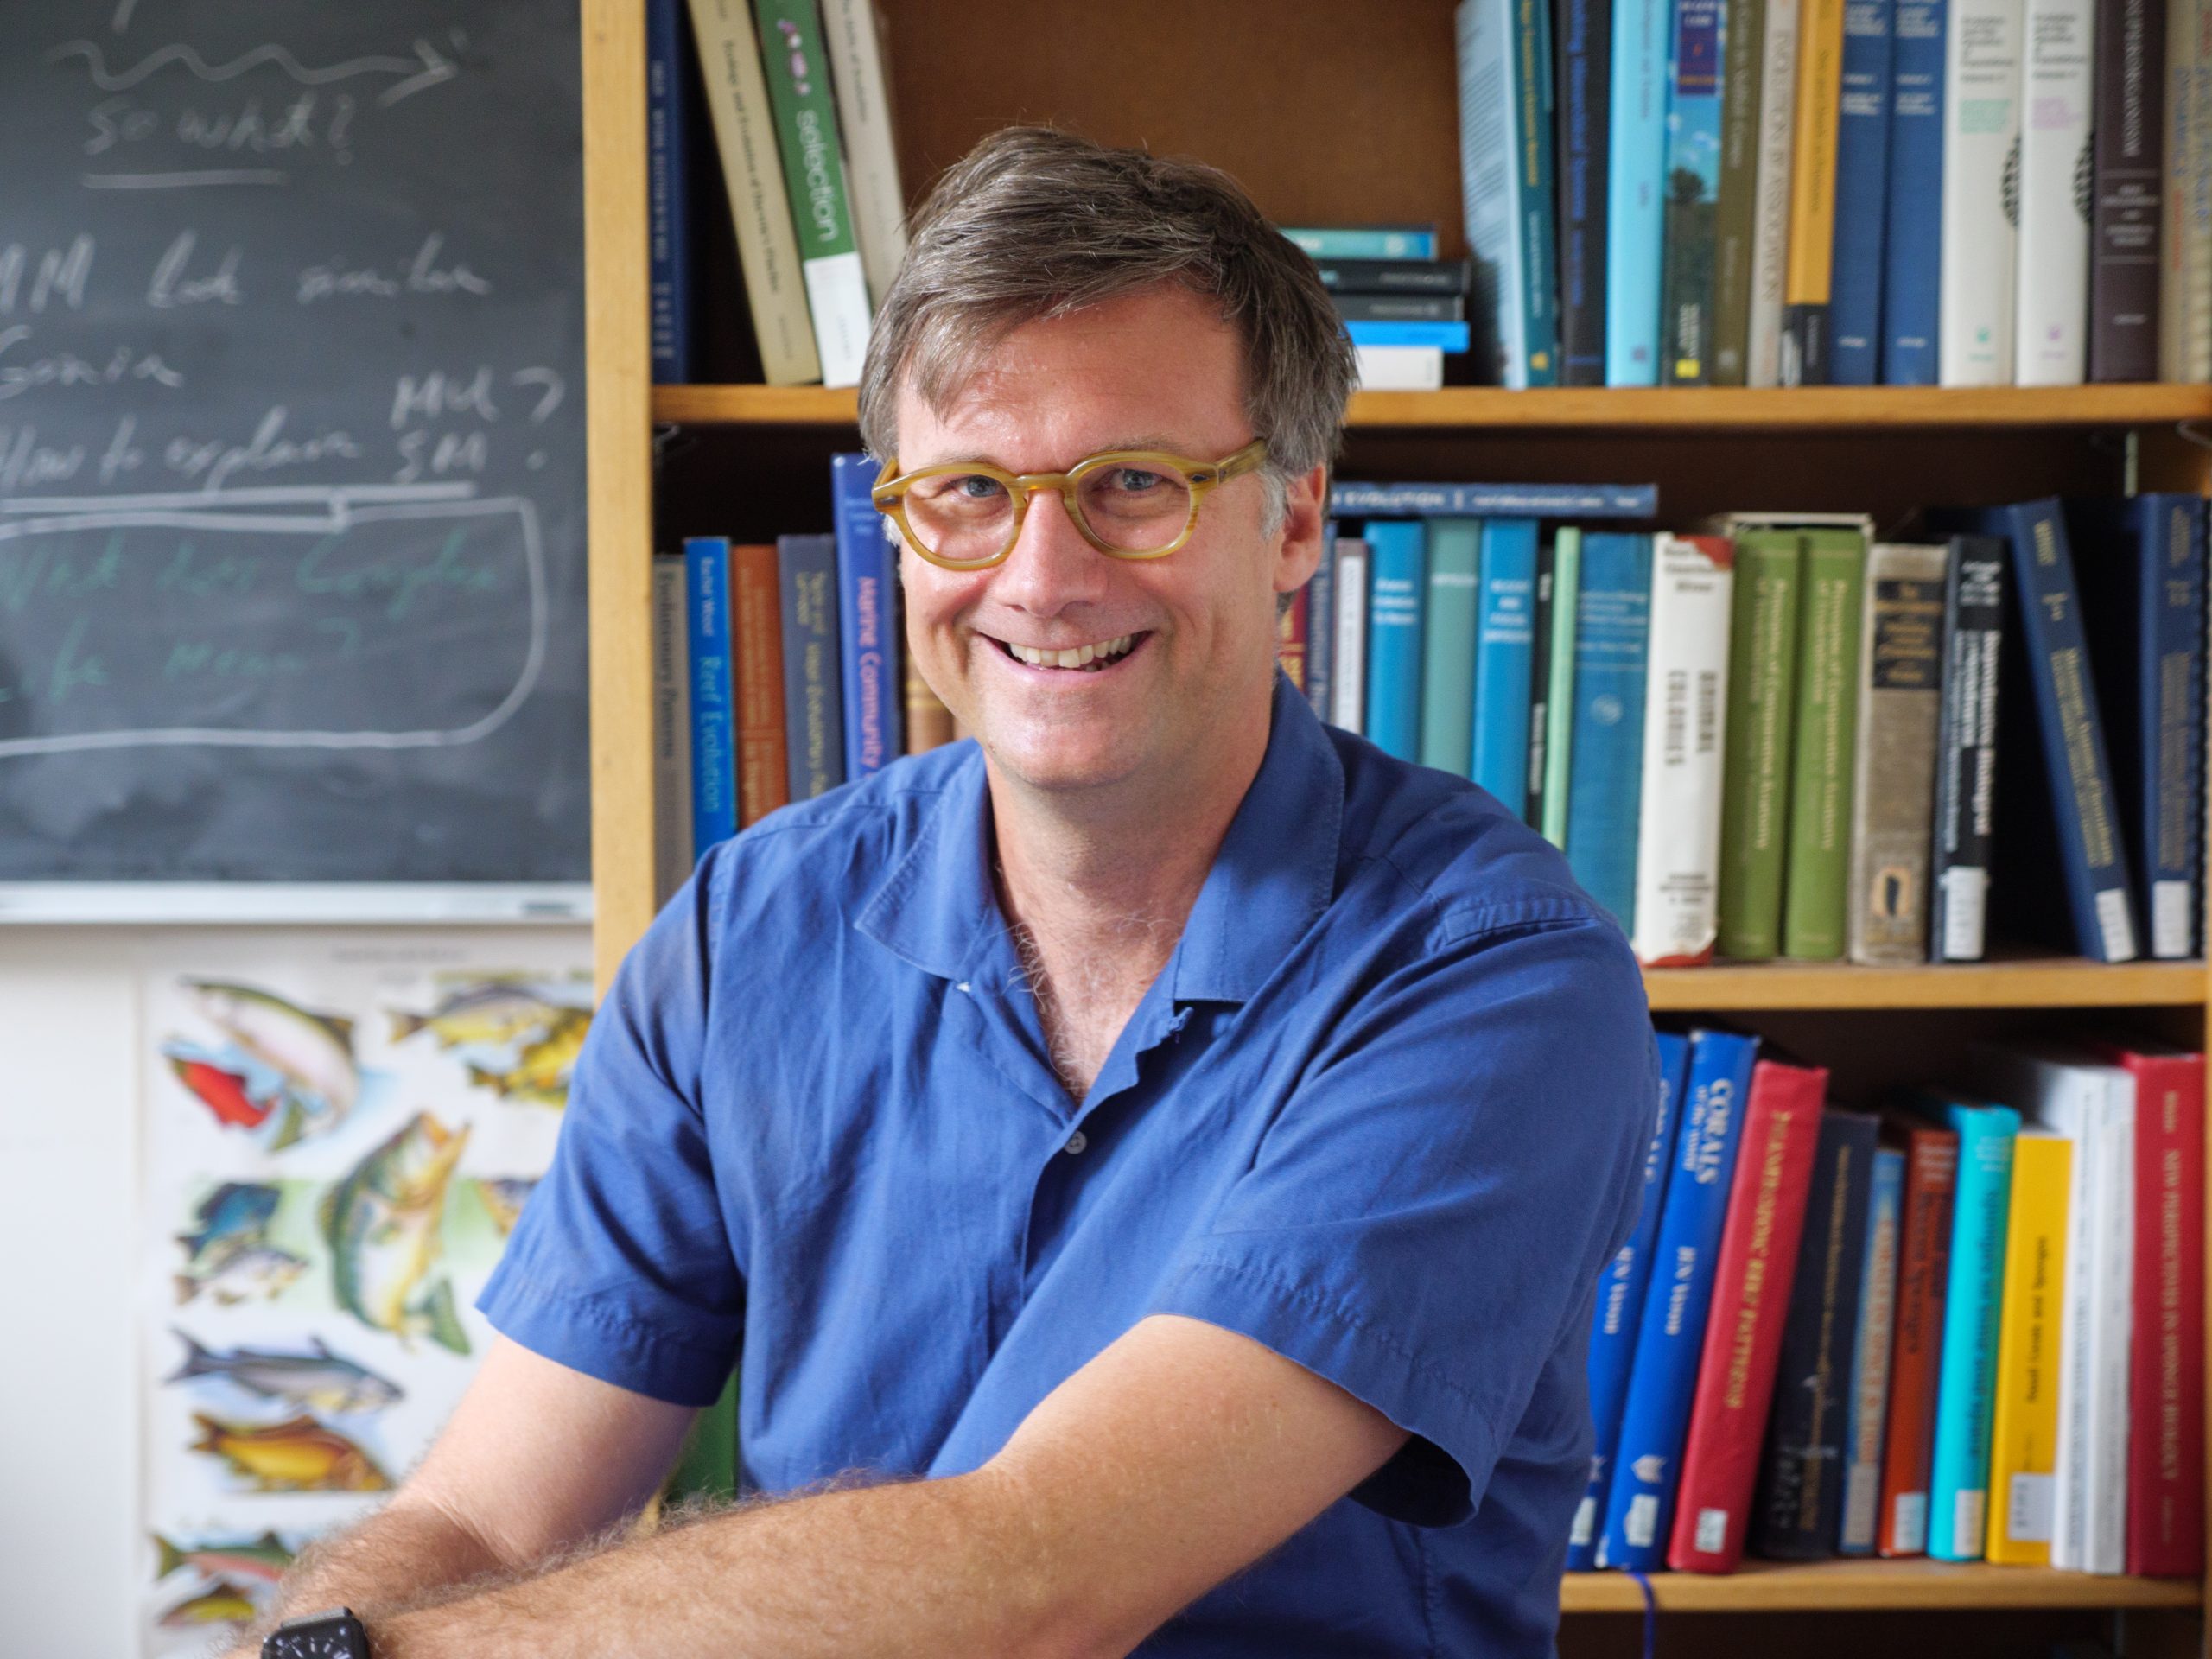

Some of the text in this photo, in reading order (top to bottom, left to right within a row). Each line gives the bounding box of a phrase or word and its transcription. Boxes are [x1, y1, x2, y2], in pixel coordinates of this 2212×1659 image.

[796, 109, 839, 242] selection
[700, 656, 724, 813] Reef Evolution
[857, 577, 882, 768] Marine Community
[1692, 1076, 1737, 1187] CORALS
